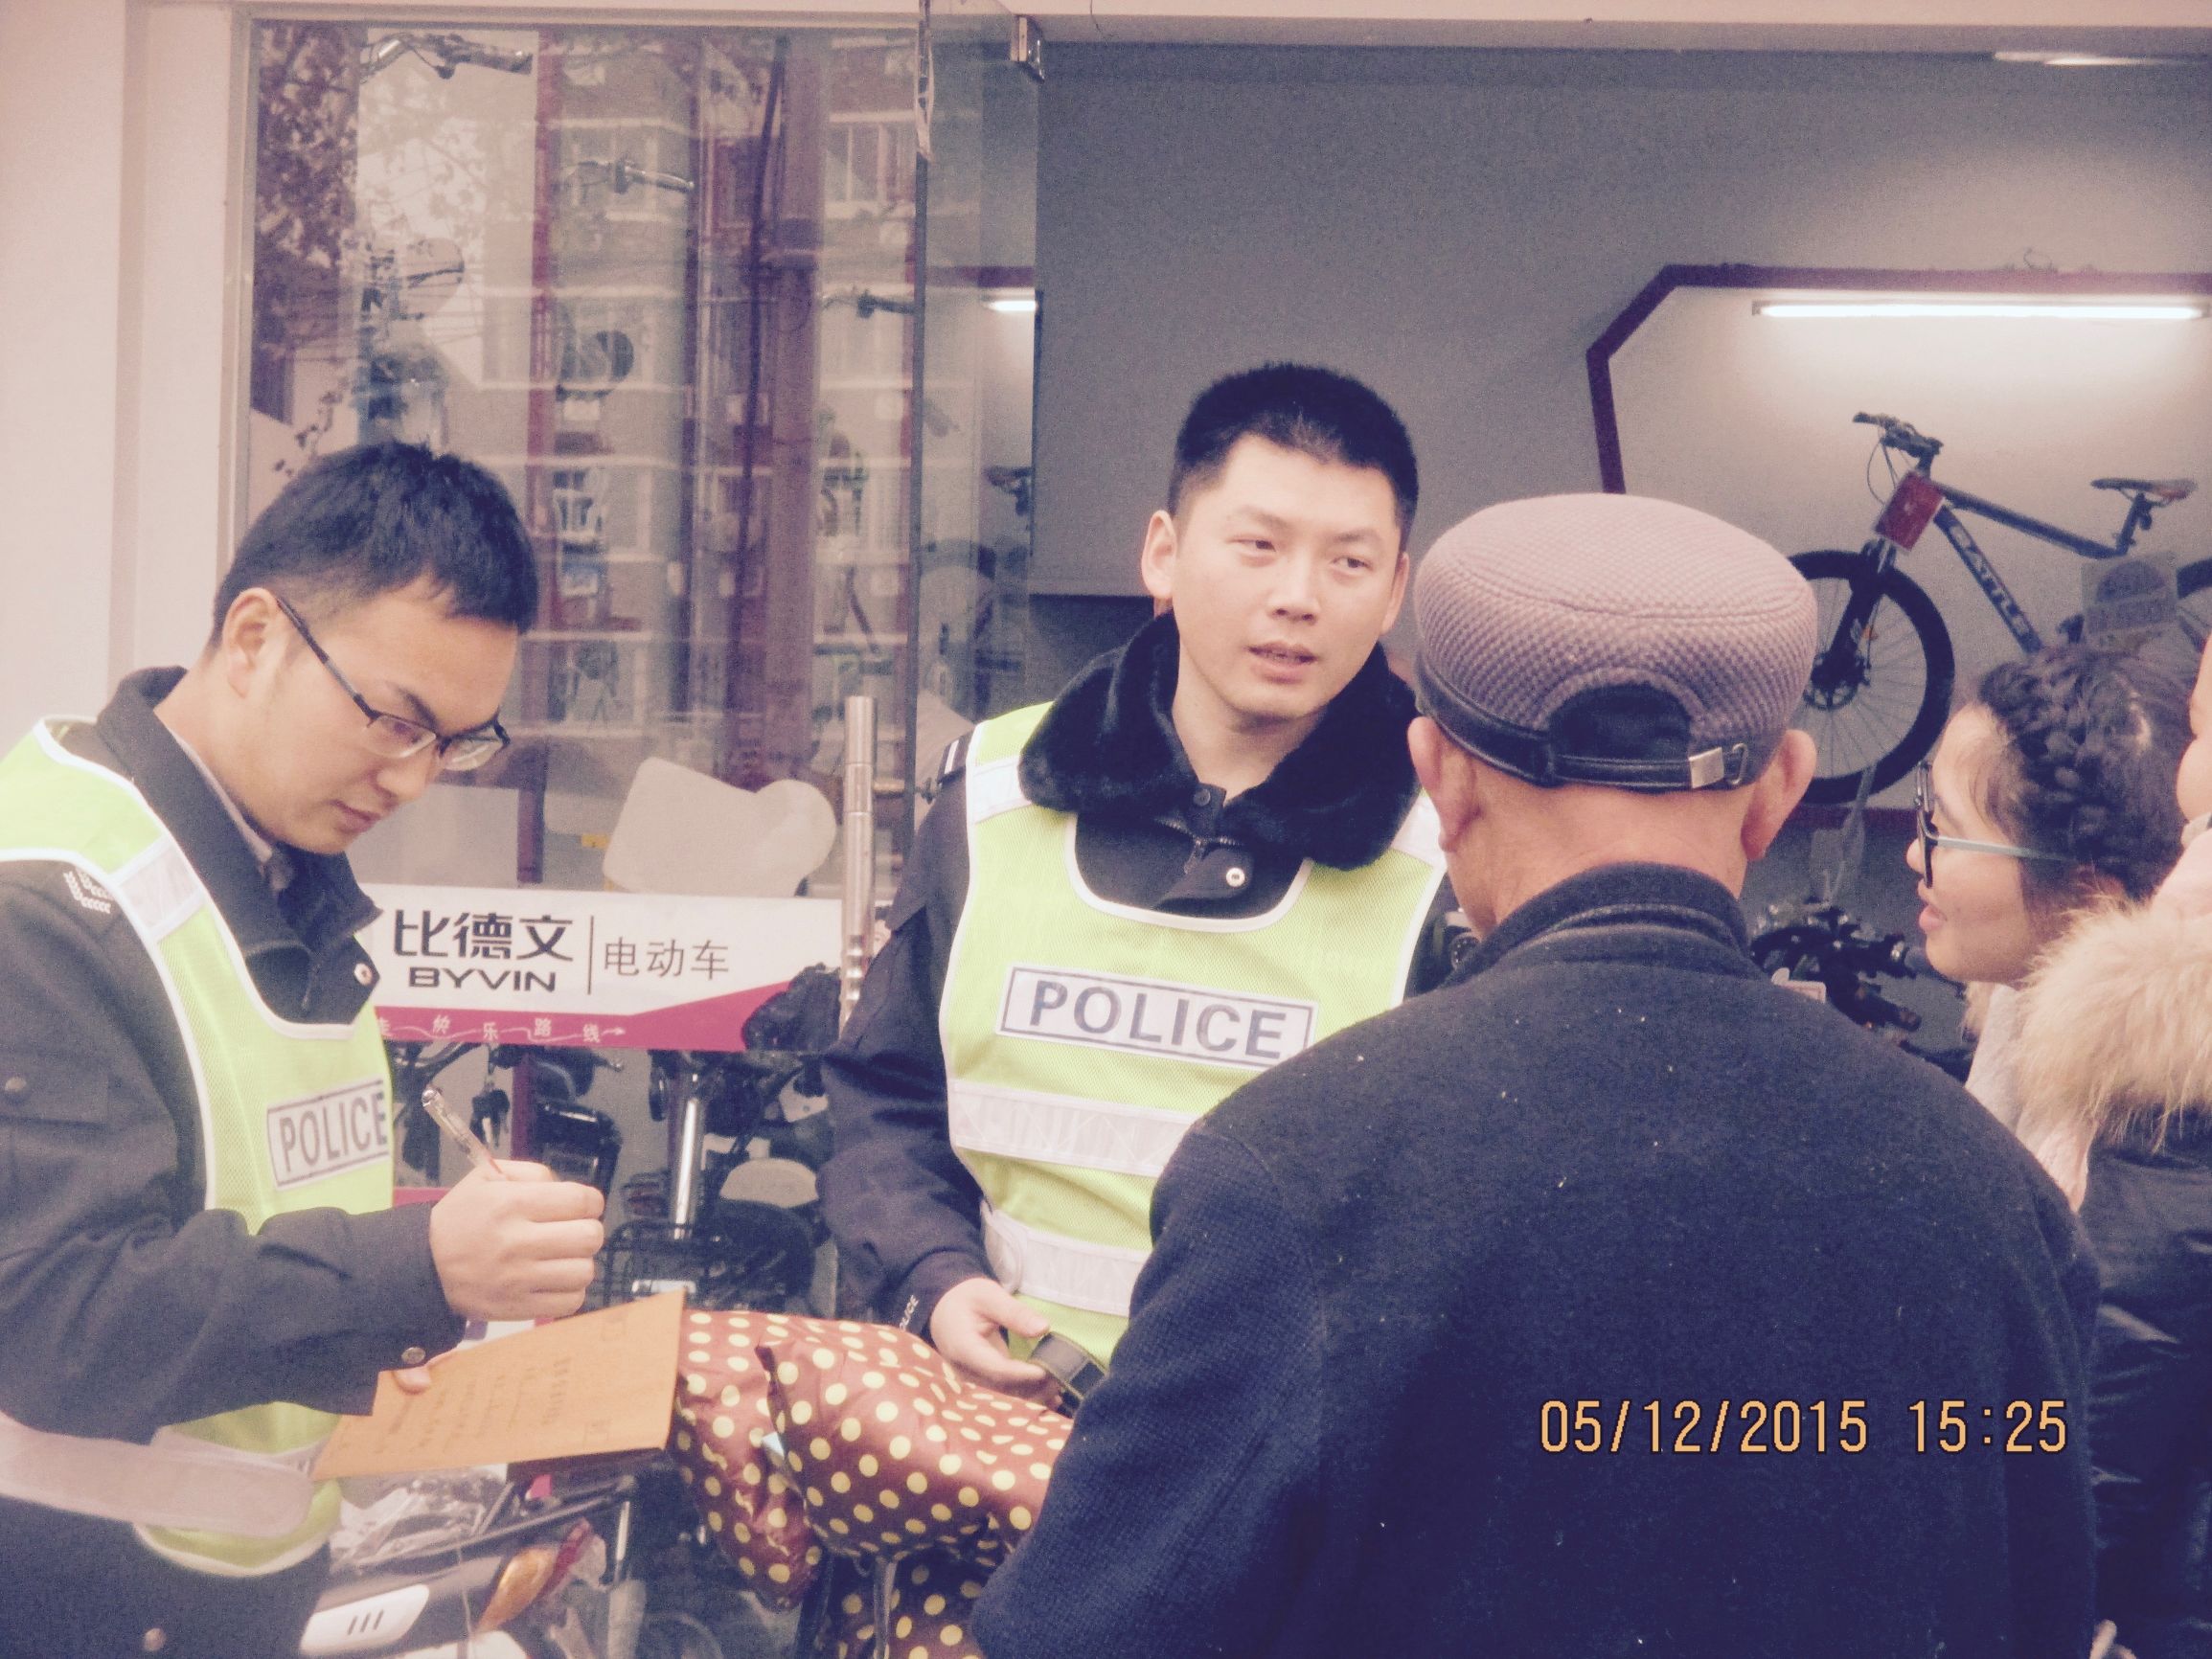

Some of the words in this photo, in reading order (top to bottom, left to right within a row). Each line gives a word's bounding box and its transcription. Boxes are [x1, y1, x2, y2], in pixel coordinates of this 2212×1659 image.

[393, 909, 573, 962] 比德文
[604, 936, 729, 980] 电动车
[408, 966, 557, 993] BYVIN
[1028, 979, 1288, 1059] POLICE
[279, 1091, 388, 1173] POLICE
